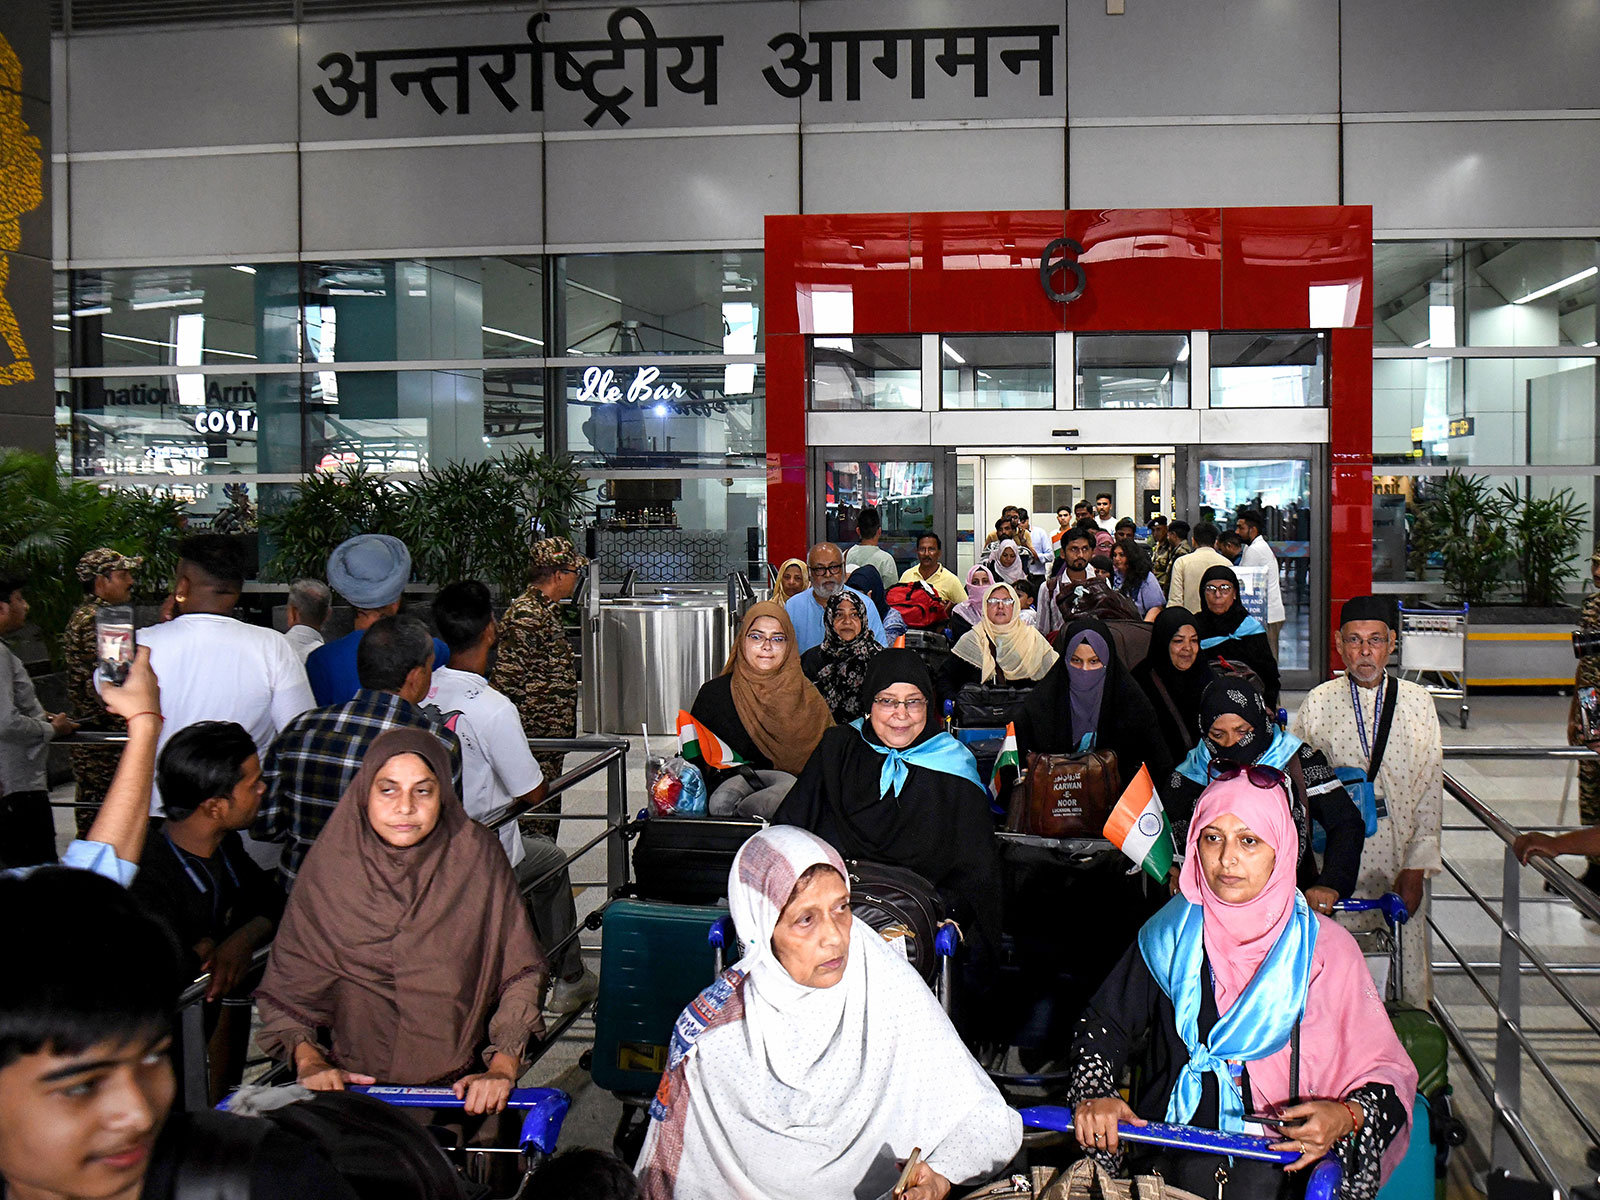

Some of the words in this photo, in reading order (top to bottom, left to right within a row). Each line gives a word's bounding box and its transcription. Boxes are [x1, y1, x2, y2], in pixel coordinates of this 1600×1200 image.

[312, 6, 724, 128] अन्तर्राष्ट्रीय
[761, 24, 1060, 102] आगमन
[1039, 237, 1087, 303] 6
[576, 366, 624, 403] Ile
[627, 366, 687, 403] Bar
[1053, 782, 1082, 790] KARWAN
[1057, 799, 1077, 807] NOOR
